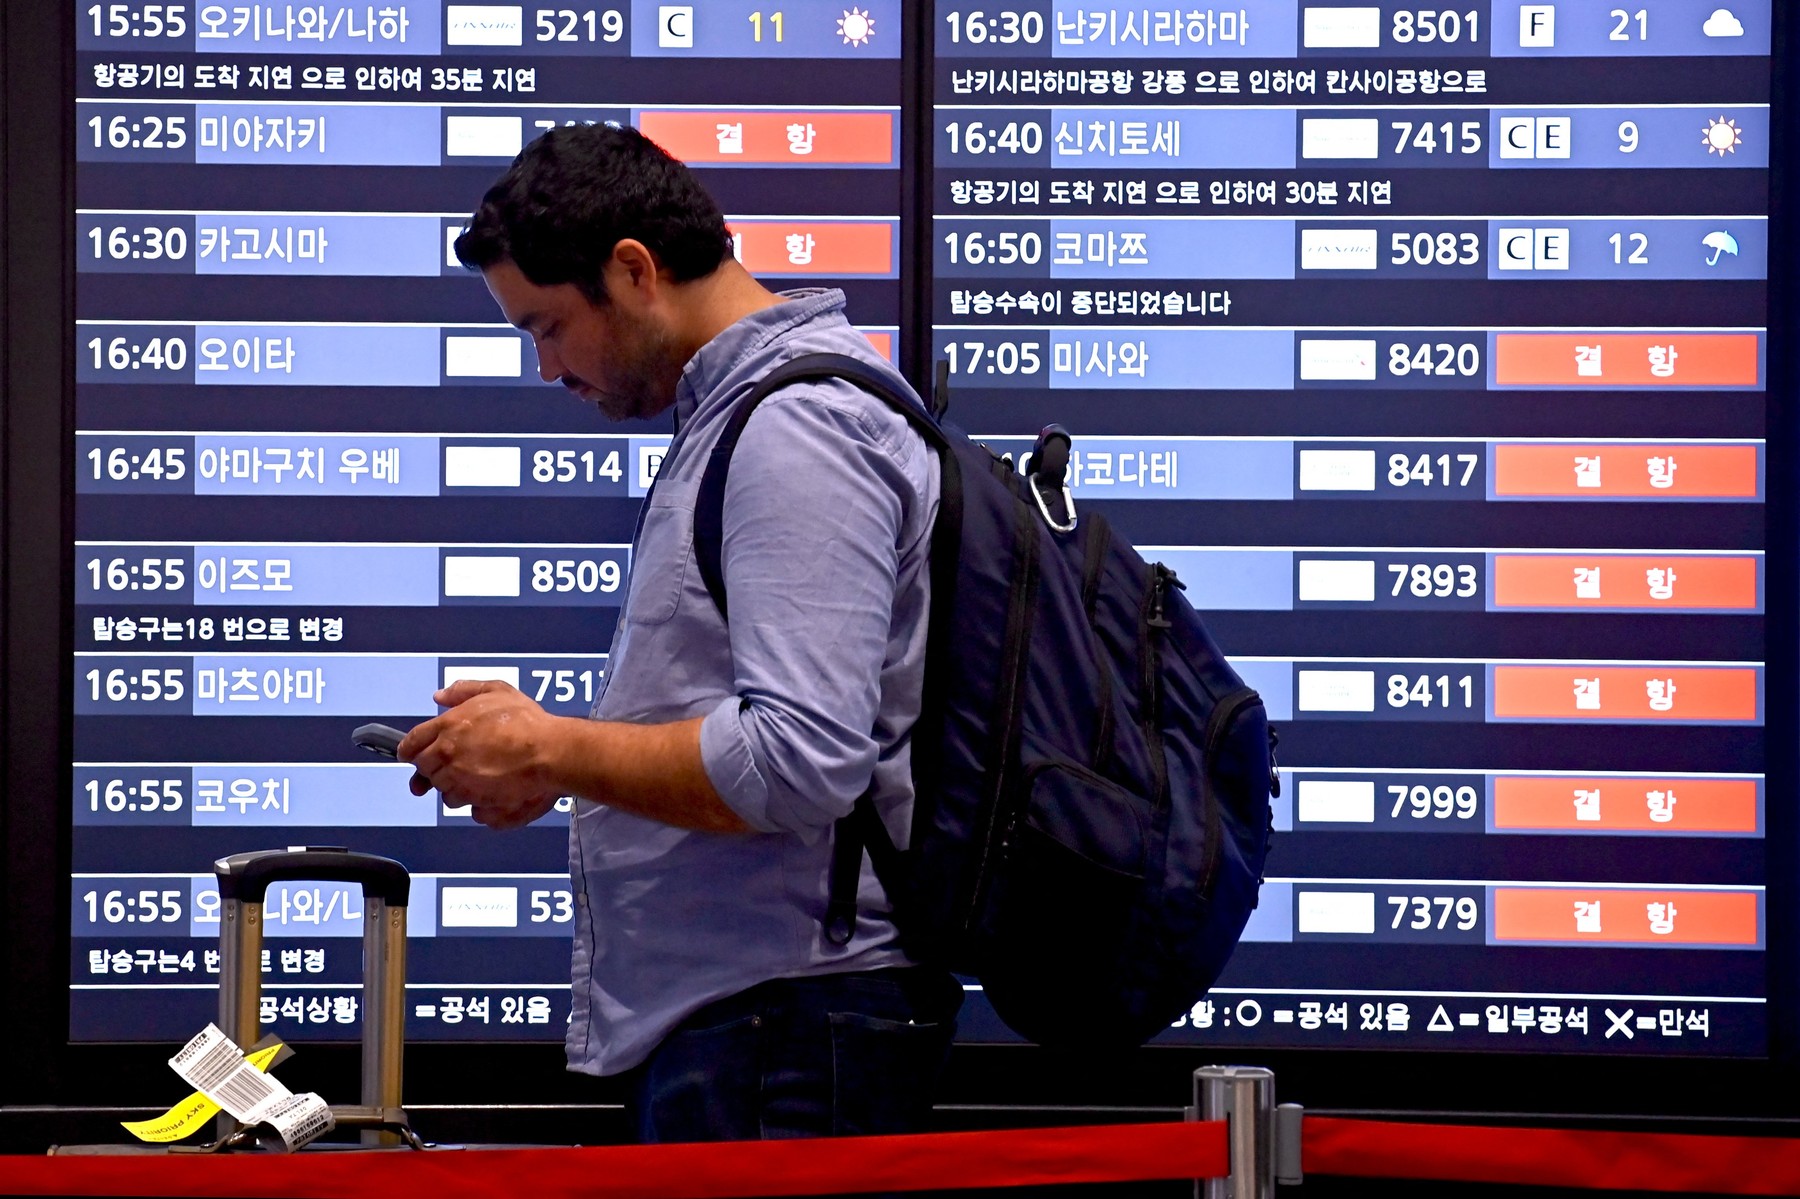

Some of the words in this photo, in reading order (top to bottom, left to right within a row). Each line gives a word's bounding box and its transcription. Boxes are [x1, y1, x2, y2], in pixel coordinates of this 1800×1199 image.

[88, 4, 186, 38] 15:55
[198, 4, 410, 43] 오키나와/나하
[536, 9, 623, 42] 5219
[667, 13, 686, 37] C
[748, 11, 783, 43] 11
[946, 11, 1044, 44] 16:30
[1057, 9, 1250, 46] 난키시라하마
[1392, 10, 1478, 43] 8501
[1531, 12, 1544, 37] F
[1609, 9, 1647, 41] 21
[93, 62, 184, 89] 항공기의
[193, 64, 241, 90] 도착
[248, 65, 292, 90] 지연
[301, 67, 347, 90] 으로
[355, 66, 422, 92] 인하여
[430, 67, 483, 92] 35분
[492, 67, 536, 92] 지연
[952, 69, 1134, 95] 난키시라하마공항
[1142, 69, 1187, 95] 강풍
[1194, 70, 1240, 93] 으로
[1249, 69, 1316, 95] 인하여
[1326, 69, 1487, 95] 칸사이공항으로
[88, 115, 187, 149] 16:25
[200, 115, 326, 153] 미야자키
[716, 122, 744, 154] 결
[786, 123, 817, 155] 항
[945, 122, 1043, 154] 16:40
[1054, 120, 1180, 157] 신치토세
[1391, 121, 1481, 154] 7415
[1508, 124, 1527, 149] C
[1546, 125, 1560, 149] E
[1618, 121, 1639, 153] 9
[950, 179, 1039, 205] 항공기의
[1049, 180, 1095, 205] 도착
[1103, 180, 1147, 205] 지연
[1155, 181, 1201, 204] 으로
[1209, 180, 1276, 205] 인하여
[1285, 181, 1339, 205] 30분
[1347, 180, 1391, 205] 지연
[88, 226, 187, 260] 16:30
[195, 225, 329, 265] 카고시마
[785, 233, 816, 265] 항
[944, 232, 1042, 265] 16:50
[1053, 230, 1149, 267] 코마쯔
[1391, 232, 1479, 265] 5083
[1506, 236, 1525, 260] C
[1544, 236, 1559, 260] E
[1608, 232, 1649, 264] 12
[950, 289, 1062, 315] 탑승수속이
[1071, 290, 1232, 316] 중단되었습니다
[88, 337, 187, 370] 16:40
[198, 336, 296, 374] 오이타
[944, 342, 1041, 375] 17:05
[1054, 340, 1149, 378] 미사와
[1388, 343, 1479, 376] 8420
[1574, 344, 1603, 377] 결
[1647, 344, 1679, 377] 항
[88, 447, 186, 480] 16:45
[199, 446, 325, 484] 야마구치
[338, 447, 400, 485] 우베
[532, 450, 623, 483] 8514
[1387, 453, 1478, 487] 8417
[1574, 455, 1602, 488] 결
[1646, 456, 1678, 489] 항
[87, 558, 185, 591] 16:55
[198, 556, 294, 594] 이즈모
[531, 559, 621, 593] 8509
[1388, 564, 1477, 598] 7893
[1573, 566, 1601, 599] 결
[1646, 567, 1677, 600] 항
[93, 616, 215, 642] 탑승구는18
[223, 616, 291, 641] 번으로
[299, 617, 343, 642] 변경
[86, 668, 184, 701] 16:55
[198, 667, 326, 704] 마츠야마
[531, 669, 604, 702] 751
[1387, 674, 1472, 708] 8411
[1573, 677, 1601, 710] 결
[1646, 678, 1677, 711] 항
[85, 779, 183, 812] 16:55
[195, 777, 290, 815] 코우치
[1387, 785, 1477, 819] 7999
[1573, 788, 1601, 821] 결
[1646, 789, 1677, 823] 항
[83, 890, 182, 923] 16:55
[193, 886, 364, 926] 오나와/
[529, 889, 573, 924] 53
[1387, 896, 1477, 931] 7379
[1573, 900, 1602, 933] 결
[1646, 901, 1678, 935] 항
[89, 949, 196, 974] 탑승구는4
[281, 948, 325, 973] 변경
[259, 996, 359, 1024] 공석상황
[500, 996, 551, 1024] 있음
[1359, 1002, 1411, 1031] 있음
[186, 1103, 205, 1120] SKY
